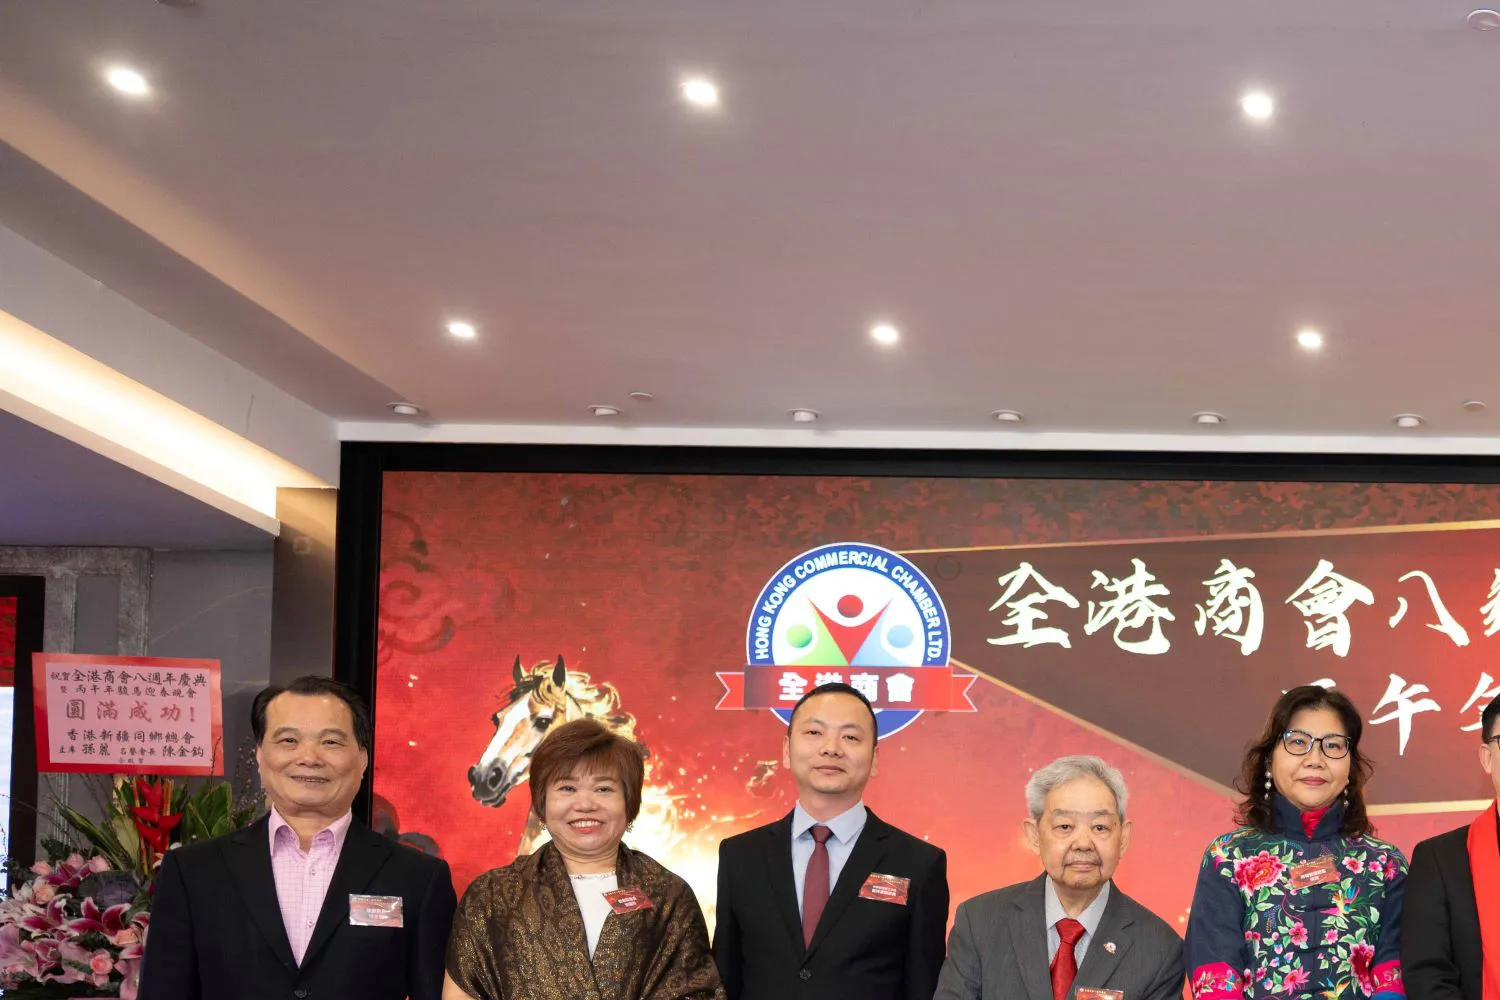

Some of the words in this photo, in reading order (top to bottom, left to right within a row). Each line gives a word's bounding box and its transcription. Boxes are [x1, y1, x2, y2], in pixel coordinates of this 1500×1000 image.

[794, 551, 888, 579] COMMERCIAL
[762, 575, 796, 614] KONG
[891, 565, 941, 629] CHAMBER
[755, 615, 772, 660] HONG
[927, 631, 943, 662] LTD.
